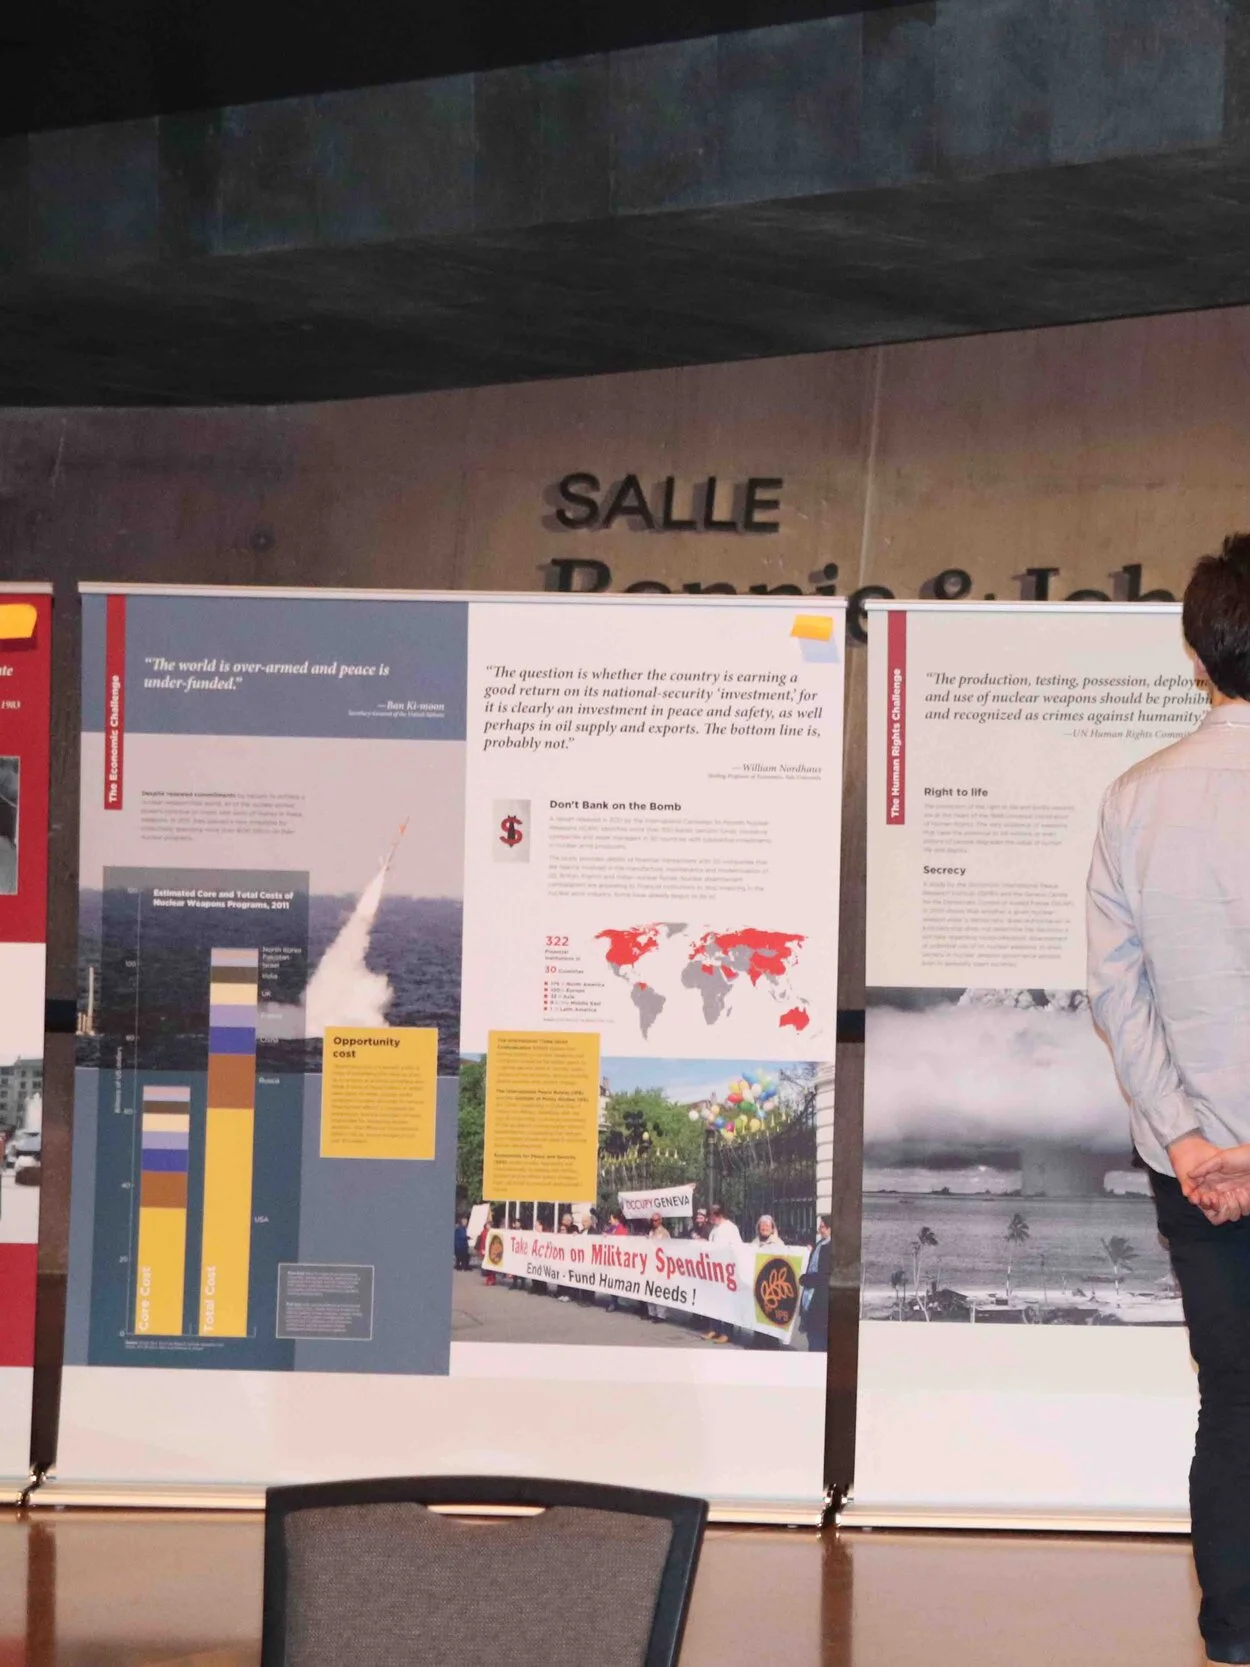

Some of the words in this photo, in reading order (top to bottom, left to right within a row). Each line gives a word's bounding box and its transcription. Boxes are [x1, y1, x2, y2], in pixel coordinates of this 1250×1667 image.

[556, 472, 783, 534] SALLE
[178, 658, 217, 672] world
[218, 663, 231, 672] is
[232, 659, 309, 674] over-armed
[310, 660, 338, 674] and
[339, 665, 377, 679] peace
[378, 666, 390, 675] is
[518, 666, 574, 682] question
[577, 671, 588, 679] is
[591, 667, 643, 680] whether
[646, 668, 668, 680] the
[669, 669, 721, 685] country
[722, 673, 734, 681] is
[736, 674, 787, 686] earning
[789, 674, 799, 683] a
[958, 672, 1032, 689] production,
[1035, 673, 1080, 689] testing,
[1082, 677, 1151, 690] possession,
[109, 675, 122, 728] Challenge
[484, 683, 516, 700] good
[519, 684, 561, 697] return
[563, 688, 581, 697] on
[583, 685, 599, 697] its
[601, 685, 714, 702] national-security
[798, 687, 818, 704] for
[891, 668, 904, 721] Challenge
[924, 708, 951, 720] and
[953, 708, 1022, 724] recognized
[1024, 713, 1040, 721] as
[1041, 713, 1085, 721] crimes
[1086, 709, 1135, 725] against
[483, 735, 542, 752] probably
[891, 722, 903, 757] Rights
[108, 729, 118, 781] Economic
[890, 758, 900, 796] Human
[108, 783, 117, 802] The
[923, 785, 954, 799] Right
[956, 786, 969, 796] to
[970, 786, 989, 797] life
[549, 799, 580, 809] Don't
[581, 799, 609, 810] Bank
[628, 800, 647, 810] the
[648, 800, 682, 811] Bomb
[890, 798, 899, 817] The
[923, 864, 966, 877] Secrecy
[153, 887, 196, 897] Estimated
[197, 887, 217, 898] Core
[218, 888, 235, 898] and
[236, 888, 259, 898] Total
[259, 888, 283, 899] Costs
[284, 889, 294, 899] of
[152, 897, 185, 907] Nuclear
[186, 898, 226, 910] Weapons
[226, 898, 270, 911] Programs,
[271, 899, 290, 909] 2011
[546, 936, 569, 947] 322
[333, 1036, 400, 1048] Opportunity
[332, 1047, 356, 1058] cost
[626, 1199, 652, 1211] OCCUPY
[654, 1195, 690, 1209] GENEVA
[254, 1216, 269, 1224] USA
[510, 1236, 528, 1253] Take
[531, 1239, 565, 1260] Action
[570, 1250, 585, 1264] on
[591, 1244, 648, 1275] Military
[655, 1247, 738, 1292] Spending
[139, 1266, 151, 1297] Cost
[204, 1266, 215, 1296] Cost
[527, 1262, 542, 1276] End
[543, 1264, 559, 1280] War
[568, 1269, 595, 1287] Fund
[599, 1275, 641, 1295] Human
[644, 1281, 687, 1305] Needs
[138, 1299, 150, 1332] Core
[203, 1299, 214, 1332] Total
